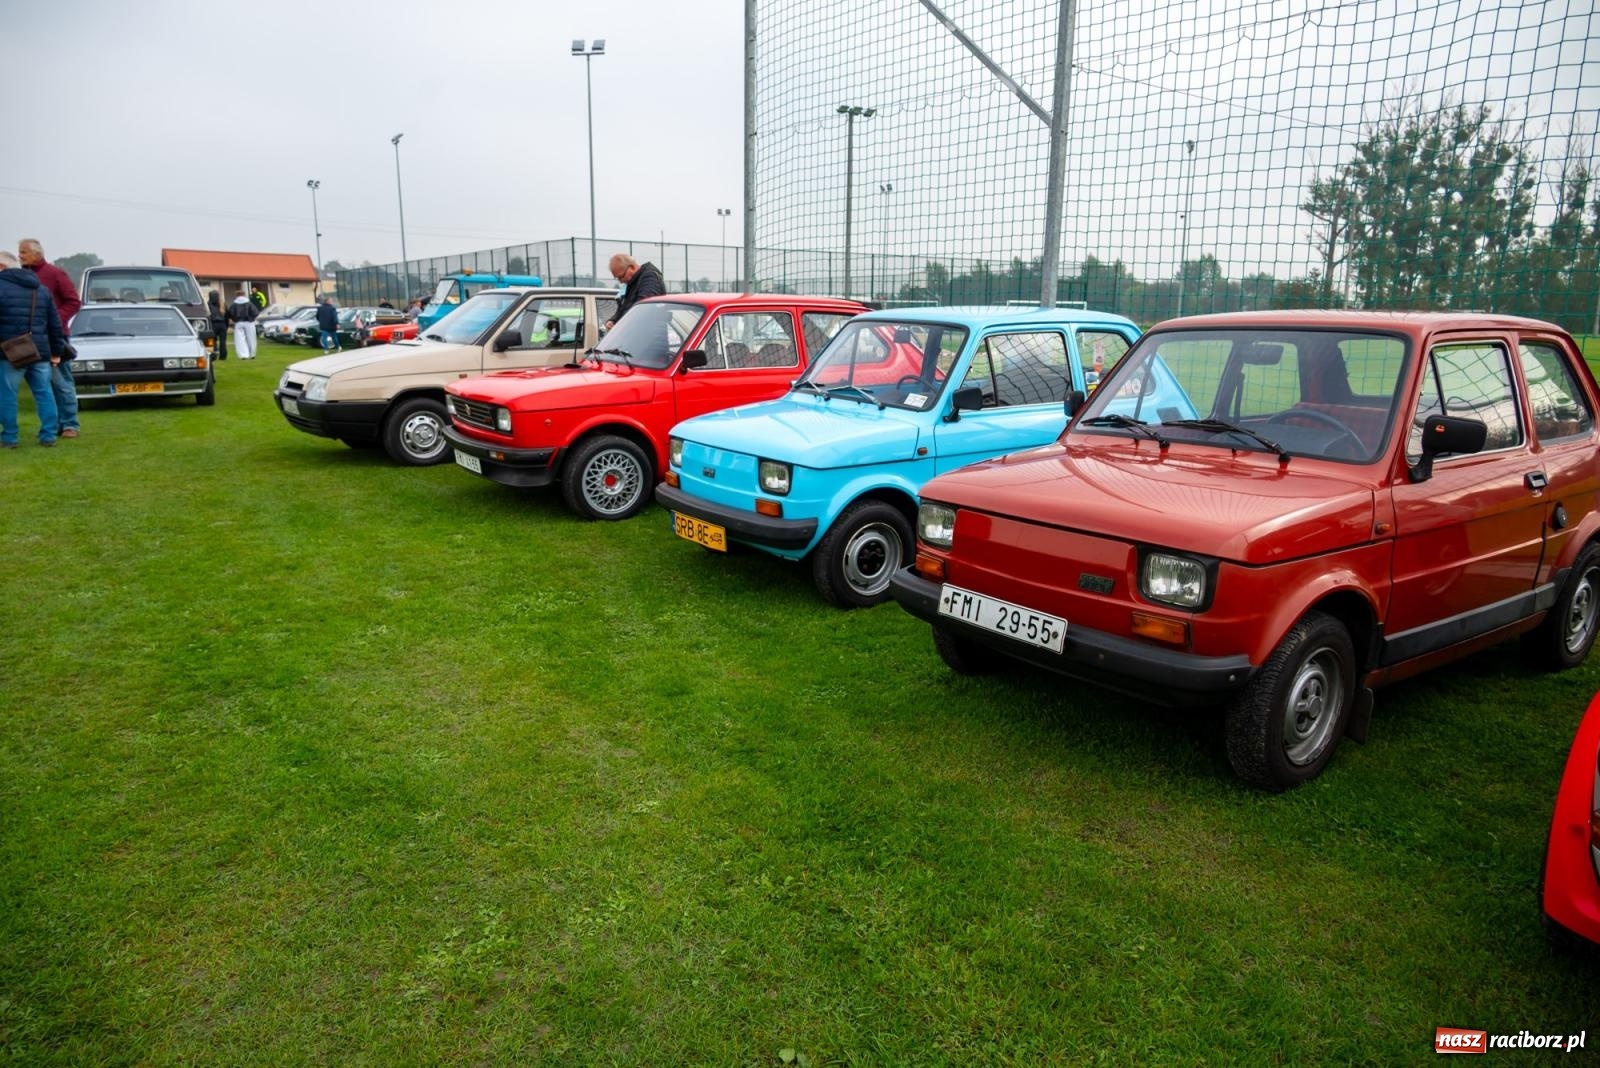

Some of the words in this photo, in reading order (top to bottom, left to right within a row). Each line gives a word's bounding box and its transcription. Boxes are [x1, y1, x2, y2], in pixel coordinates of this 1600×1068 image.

[116, 383, 130, 393] SG
[676, 515, 694, 538] SRB
[698, 523, 709, 544] 8E
[950, 591, 981, 622] FMI
[996, 606, 1053, 644] 29-55
